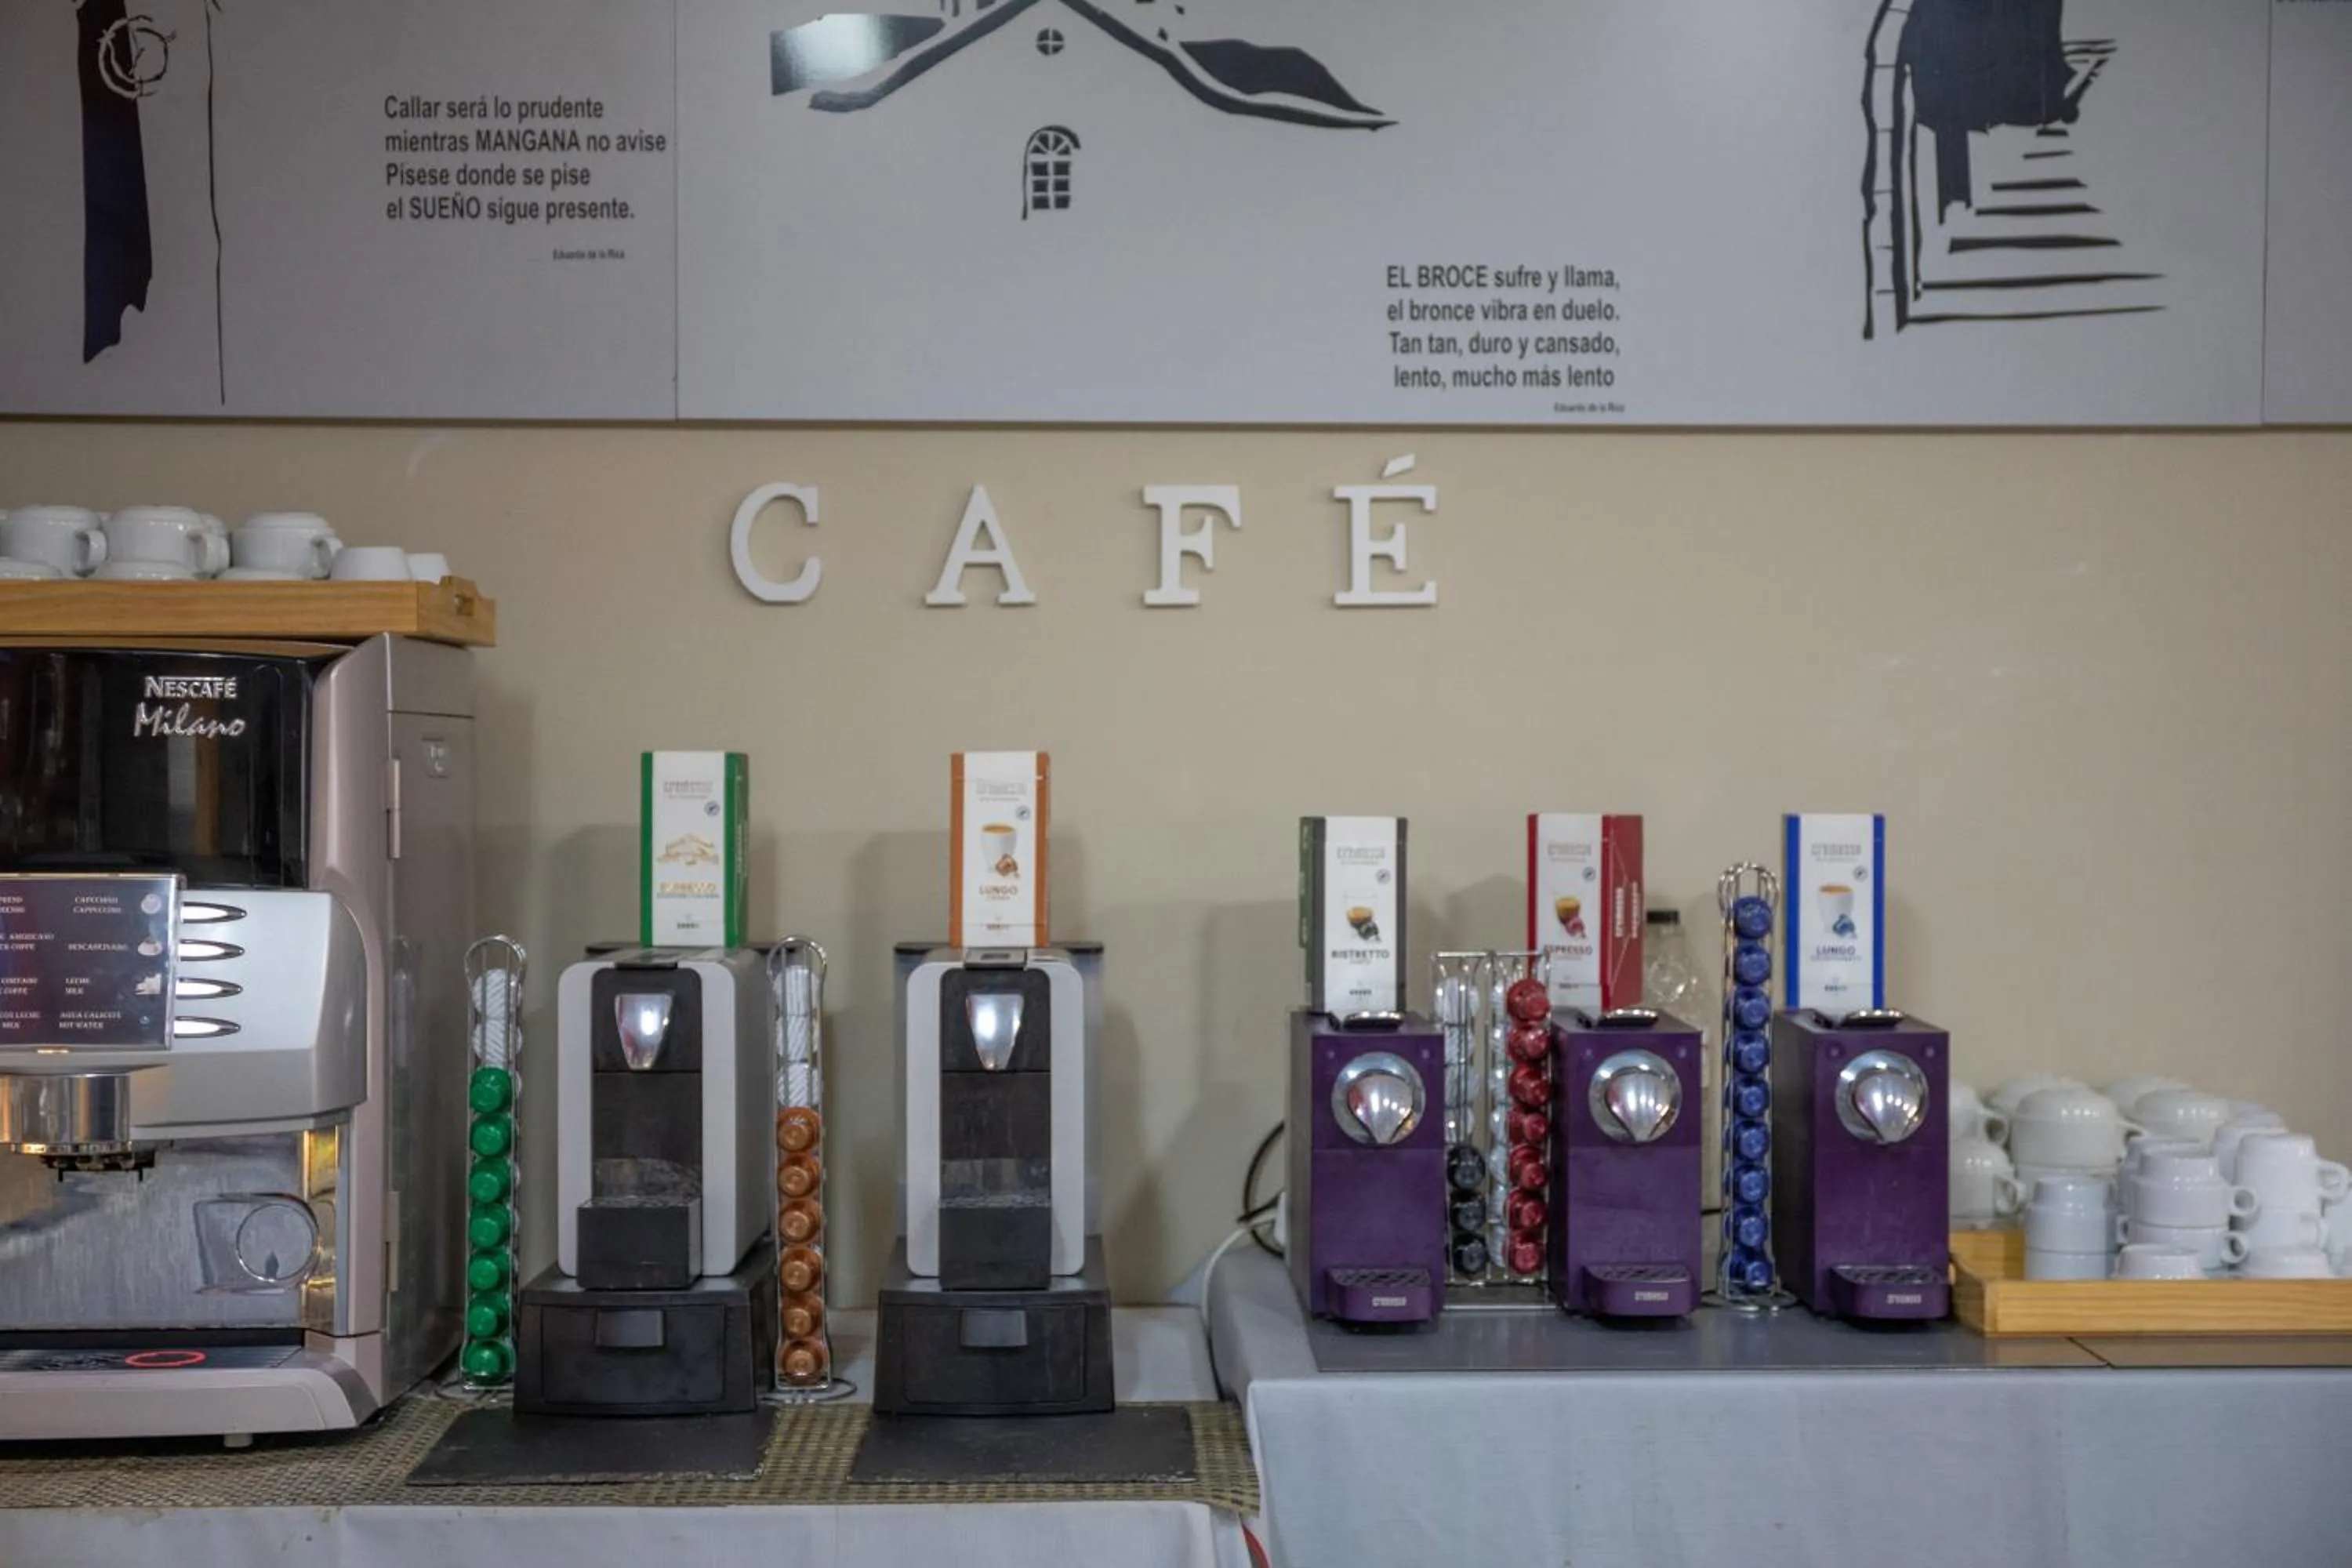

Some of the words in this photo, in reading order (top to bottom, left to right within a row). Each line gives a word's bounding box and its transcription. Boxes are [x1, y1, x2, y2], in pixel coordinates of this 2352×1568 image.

[384, 95, 441, 119] Callar
[446, 96, 488, 119] será
[494, 96, 512, 118] lo
[517, 95, 604, 124] prudente
[385, 129, 469, 152] mientras
[476, 129, 581, 152] MANGANA
[586, 134, 611, 152] no
[616, 129, 666, 152] avise
[456, 163, 517, 187] donde
[522, 168, 545, 186] se
[550, 162, 591, 191] pise
[387, 197, 403, 220] el
[409, 191, 481, 220] SUEÑO
[487, 197, 539, 225] sigue
[546, 198, 634, 224] presente.
[1387, 265, 1411, 289] EL
[1417, 264, 1487, 289] BROCE
[1494, 264, 1542, 288] sufre
[1548, 271, 1558, 294] y
[1564, 265, 1620, 291] llama,
[1387, 299, 1403, 321] el
[1409, 299, 1475, 321] bronce
[1481, 299, 1528, 321] vibra
[1533, 303, 1556, 321] en
[1562, 299, 1620, 321] duelo.
[1388, 331, 1422, 354] Tan
[1428, 333, 1463, 357] tan,
[1468, 332, 1513, 354] duro
[1518, 337, 1529, 360] y
[1534, 332, 1620, 356] cansado,
[1394, 365, 1446, 390] lento,
[1452, 365, 1517, 387] mucho
[1523, 365, 1562, 387] más
[1567, 365, 1615, 387] lento
[731, 454, 1437, 604] CAFÉ
[144, 676, 237, 699] NESCAFÉ
[133, 702, 246, 739] Milano
[1330, 949, 1390, 960] RISTRETTO
[1816, 946, 1856, 956] LUNGO
